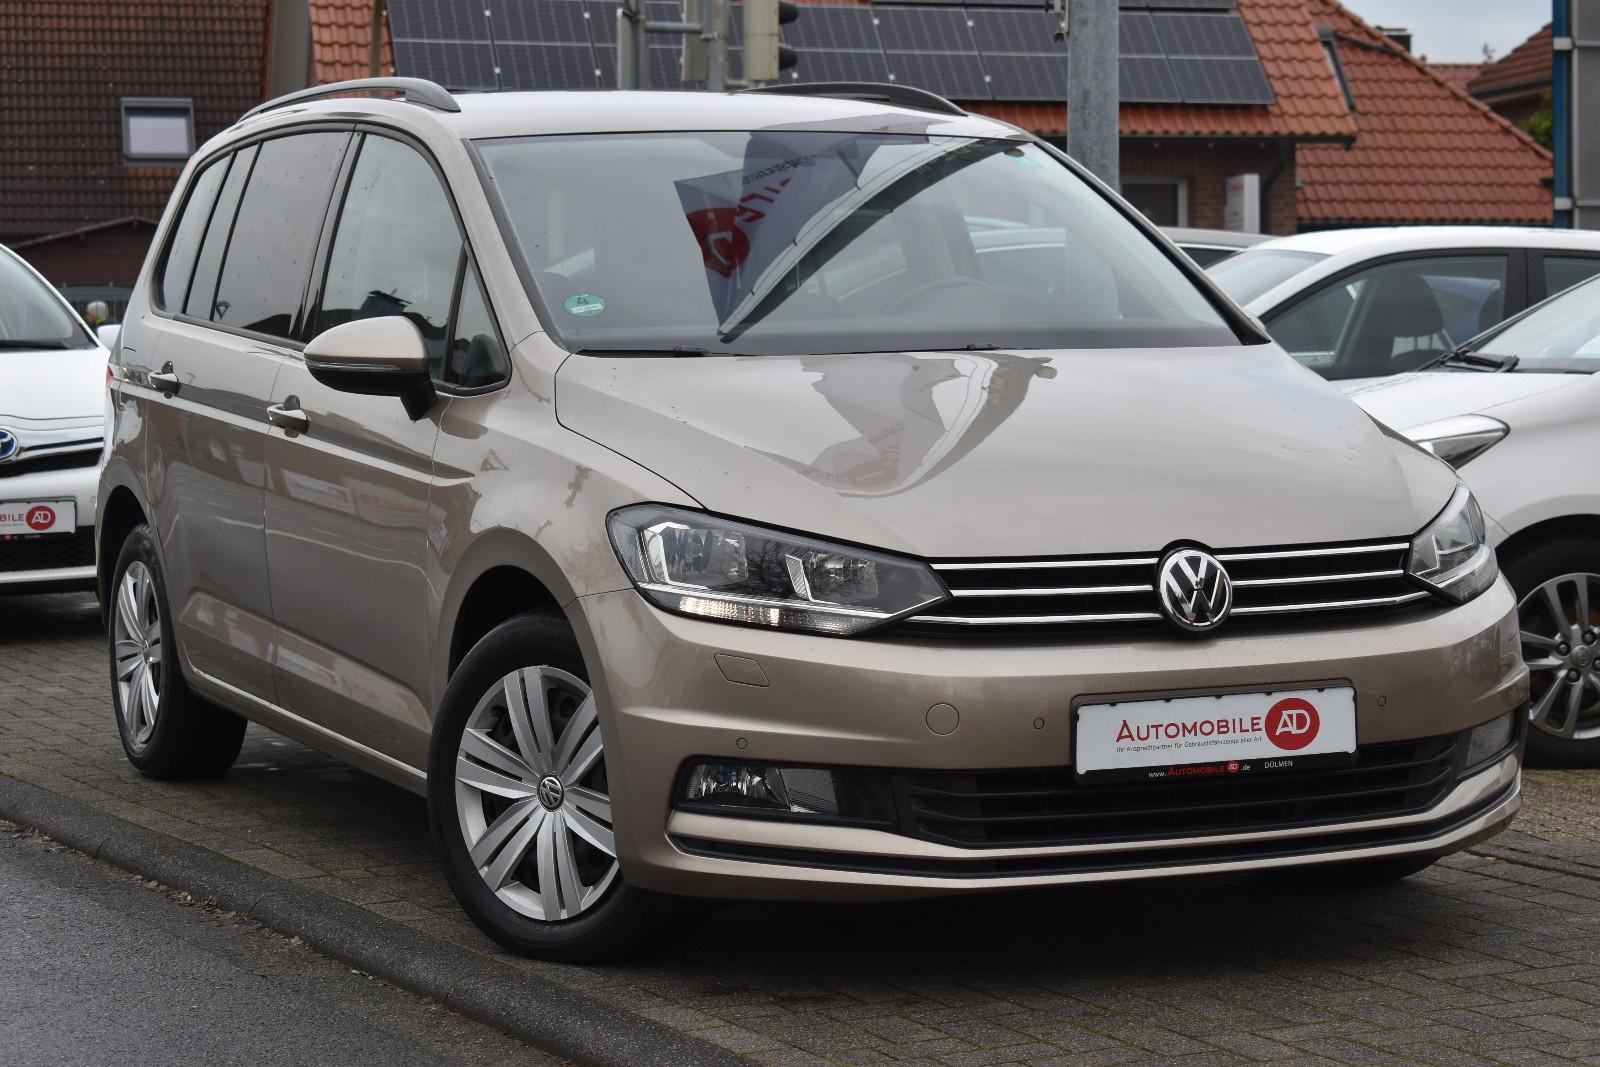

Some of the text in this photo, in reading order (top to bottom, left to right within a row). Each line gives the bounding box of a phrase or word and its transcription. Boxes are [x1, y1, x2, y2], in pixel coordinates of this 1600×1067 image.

[31, 510, 51, 524] AD
[1116, 709, 1311, 742] AUTOMOBILE AD
[1264, 760, 1293, 769] DÜLMEN
